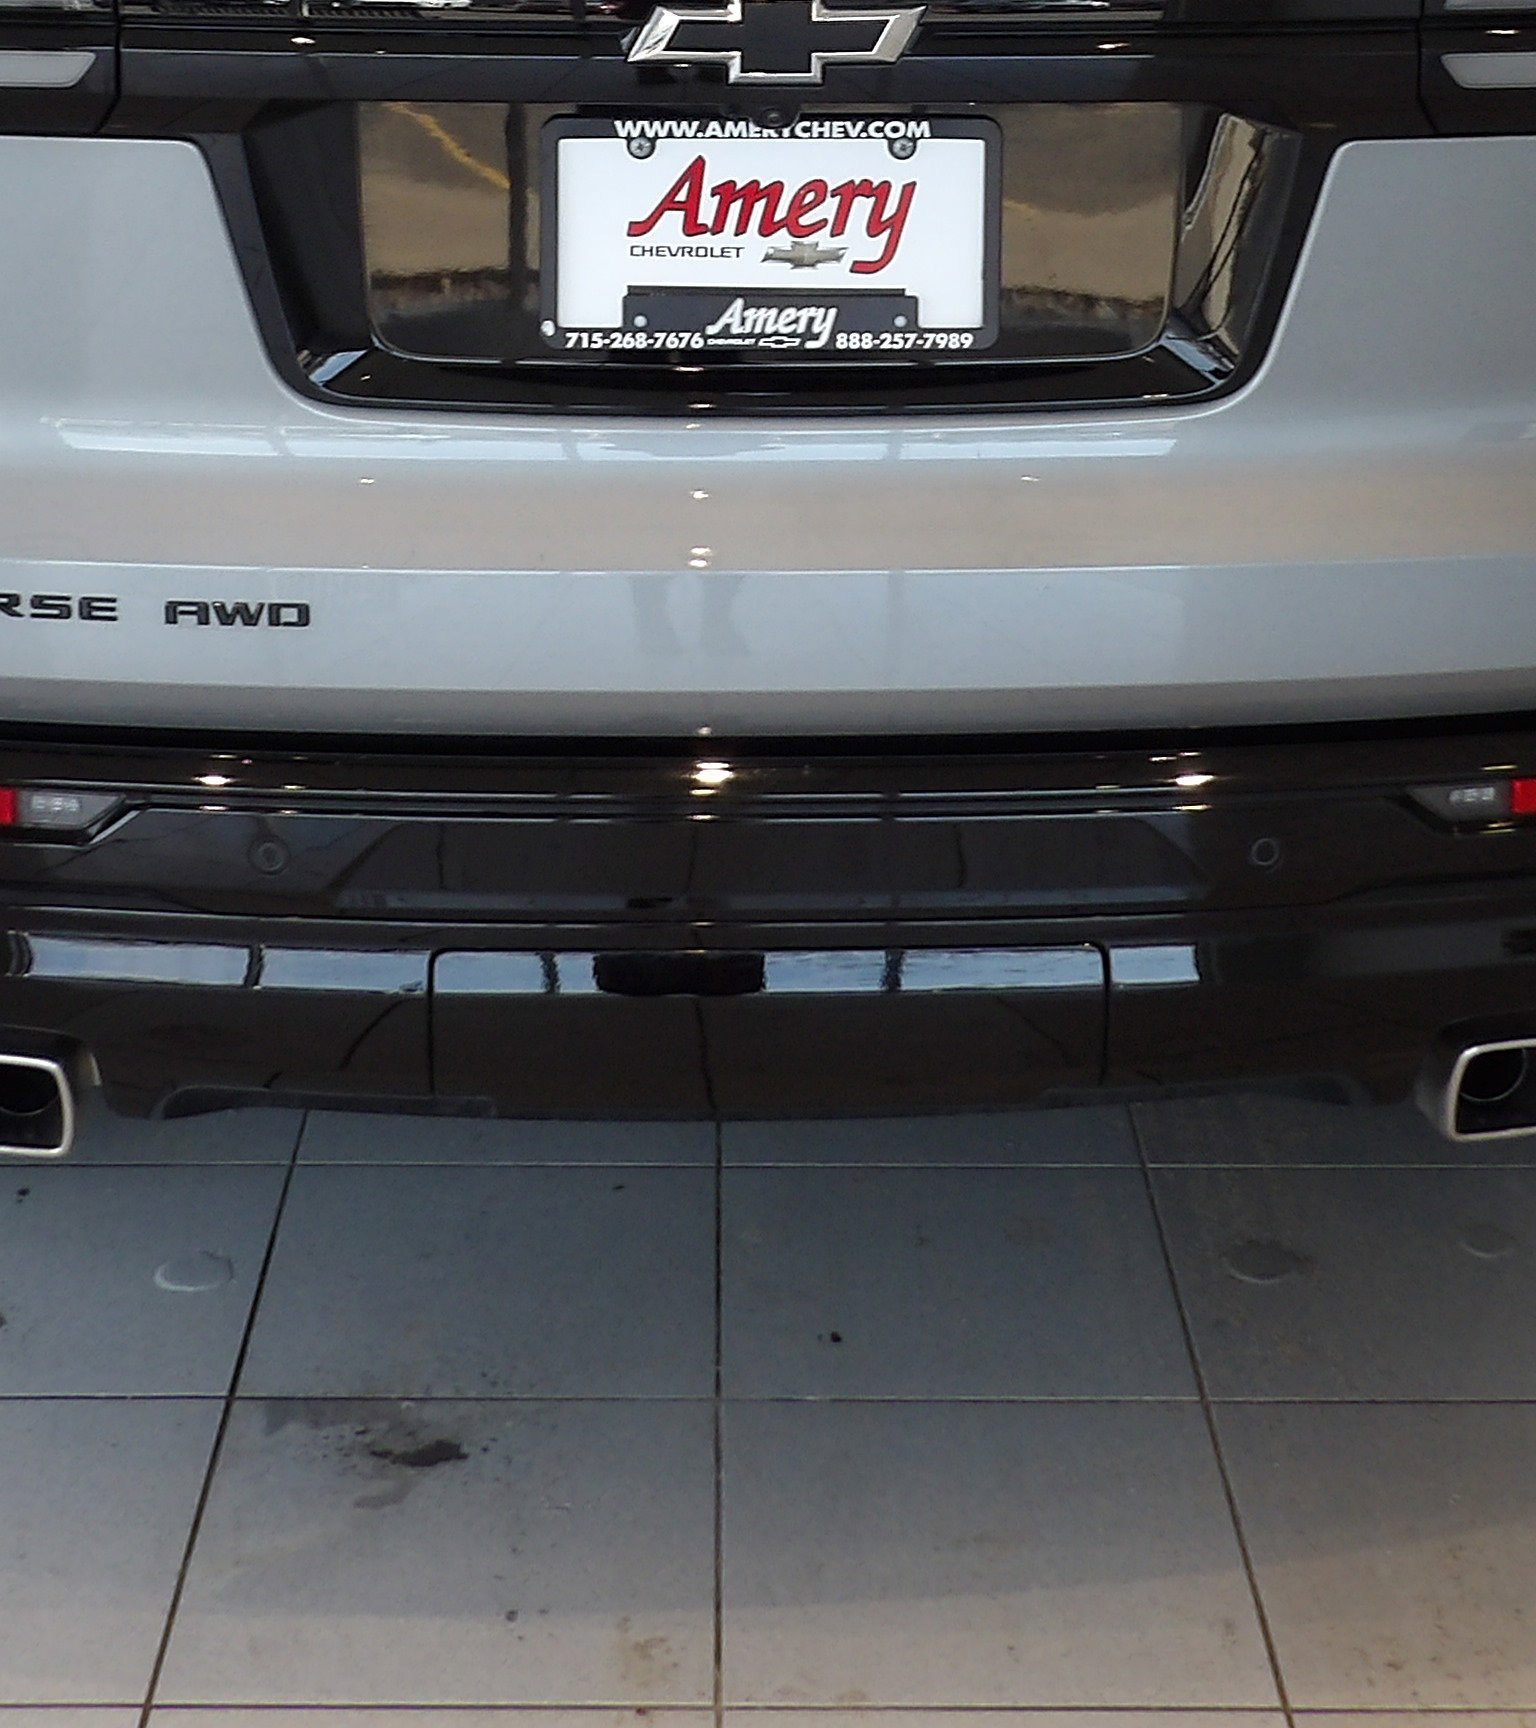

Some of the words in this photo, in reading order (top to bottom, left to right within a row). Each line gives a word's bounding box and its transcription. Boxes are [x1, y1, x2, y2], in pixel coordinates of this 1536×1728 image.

[627, 155, 917, 274] Amery
[630, 245, 745, 259] CHEVROLET
[705, 297, 838, 349] Amery
[566, 332, 704, 349] 715-268-7676
[835, 332, 973, 349] 888-257-7989
[164, 600, 311, 627] AWD
